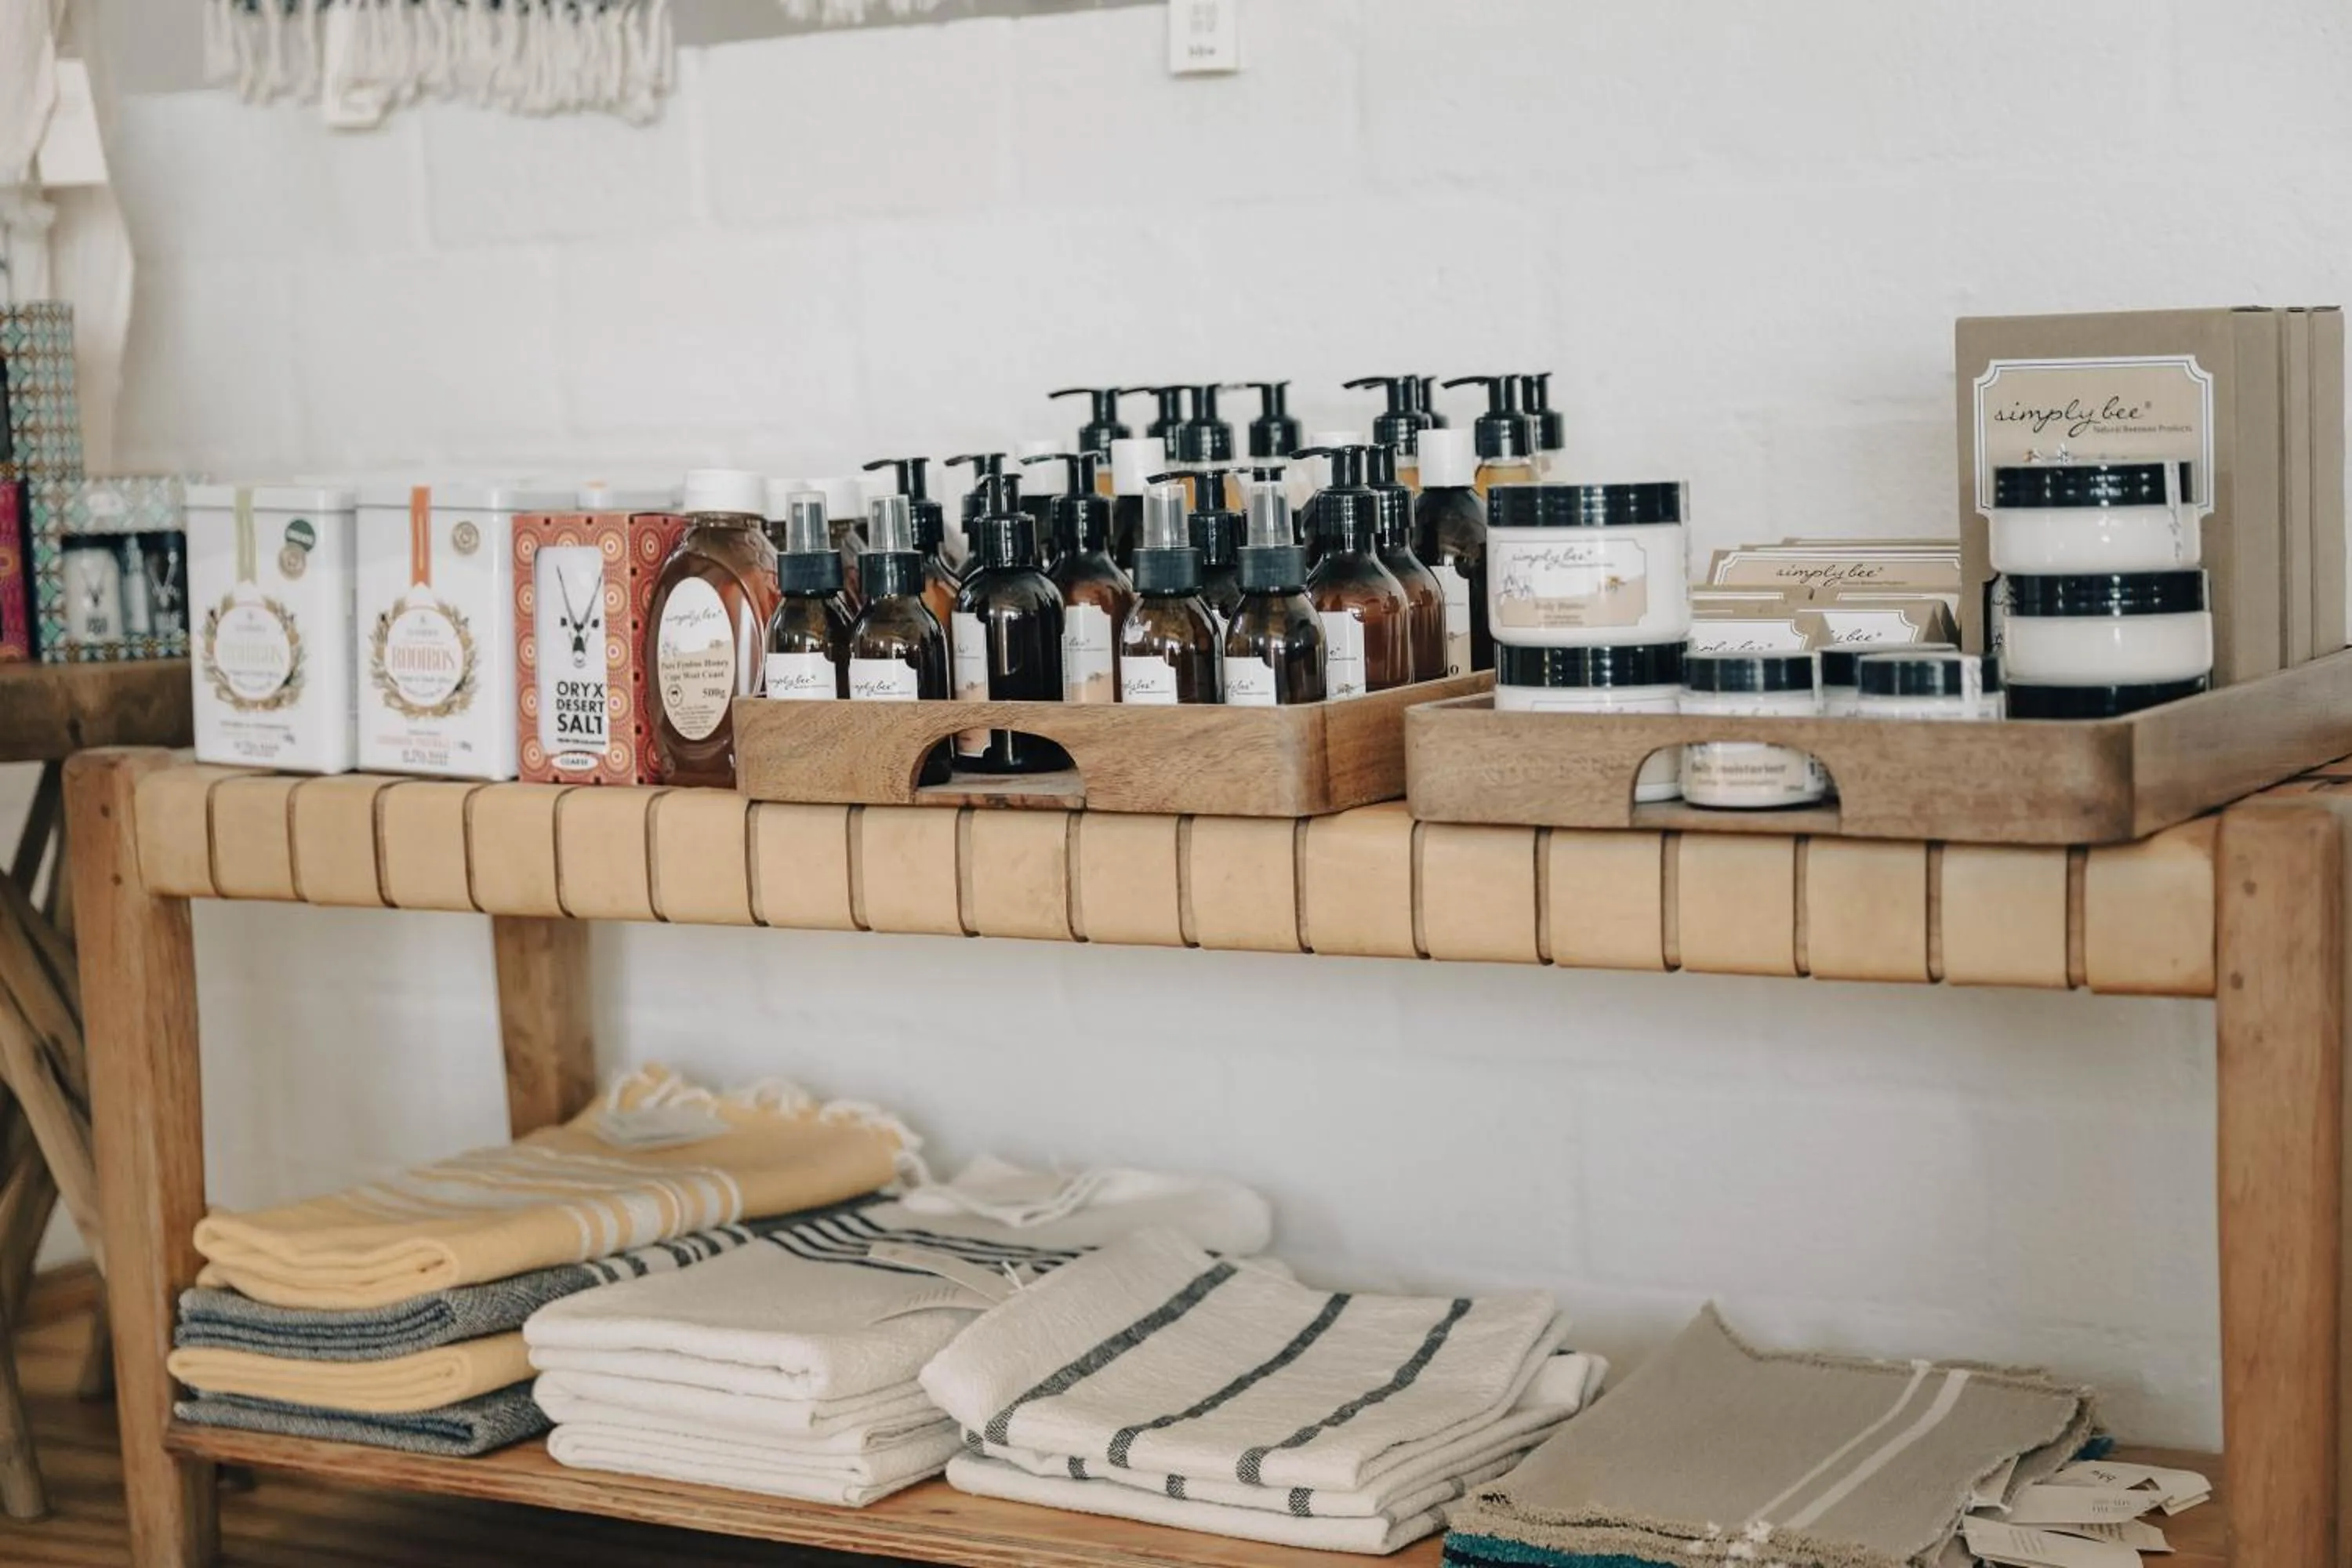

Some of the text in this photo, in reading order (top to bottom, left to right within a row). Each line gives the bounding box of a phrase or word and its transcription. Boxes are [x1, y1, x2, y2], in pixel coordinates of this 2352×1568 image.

[1994, 395, 2143, 437] simply bee
[1512, 546, 1562, 571] simply
[1776, 563, 1878, 587] simply bee
[557, 681, 604, 698] ORYX
[557, 699, 605, 713] DESERT
[557, 713, 603, 735] SALT
